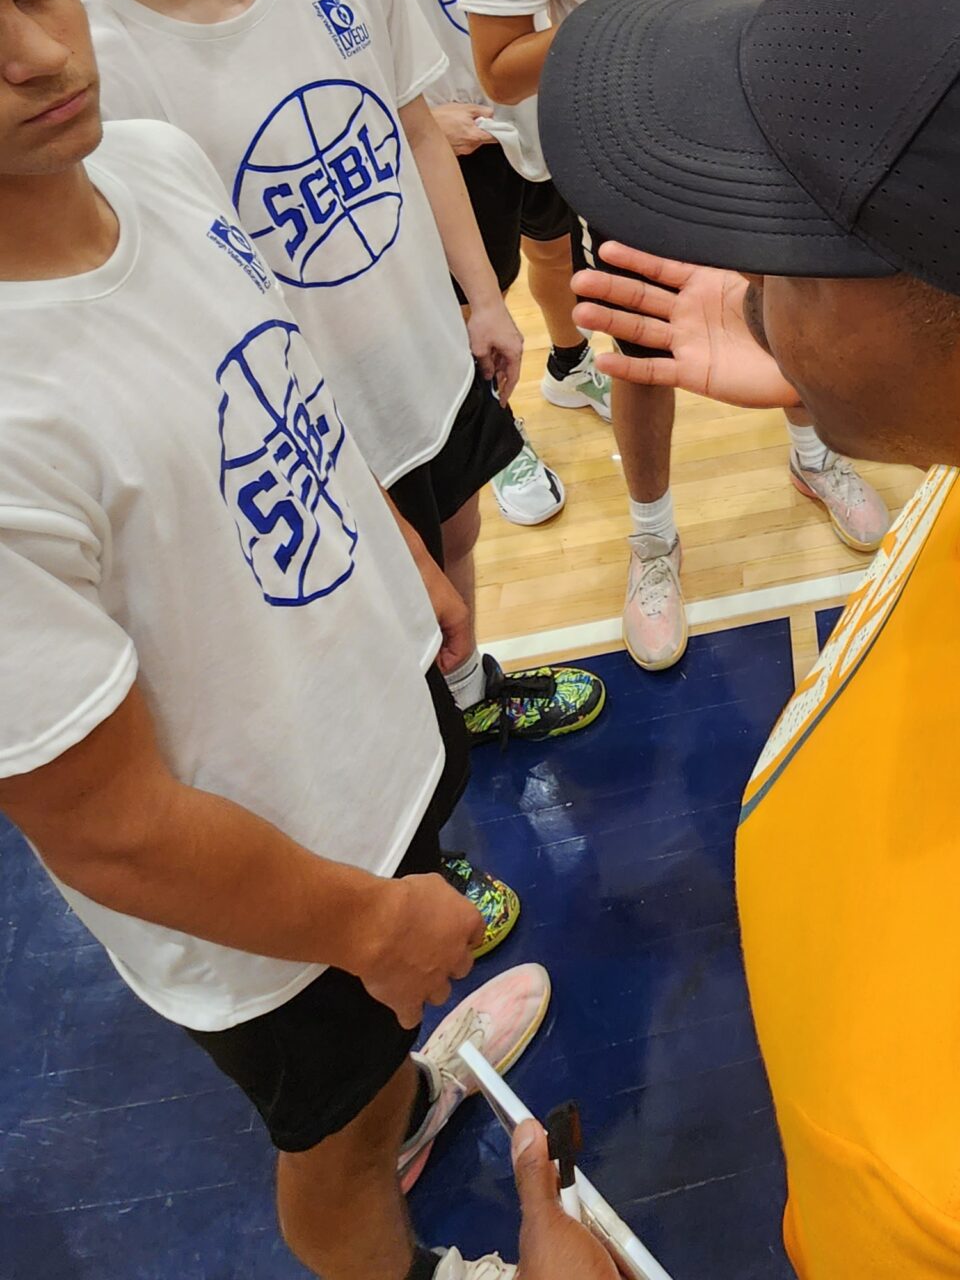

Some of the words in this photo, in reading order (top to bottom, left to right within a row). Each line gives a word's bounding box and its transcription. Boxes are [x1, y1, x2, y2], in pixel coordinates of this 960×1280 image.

[339, 22, 369, 51] LVECU
[263, 123, 394, 261] SCBL
[206, 231, 227, 251] Lehigh
[227, 248, 244, 267] Valley
